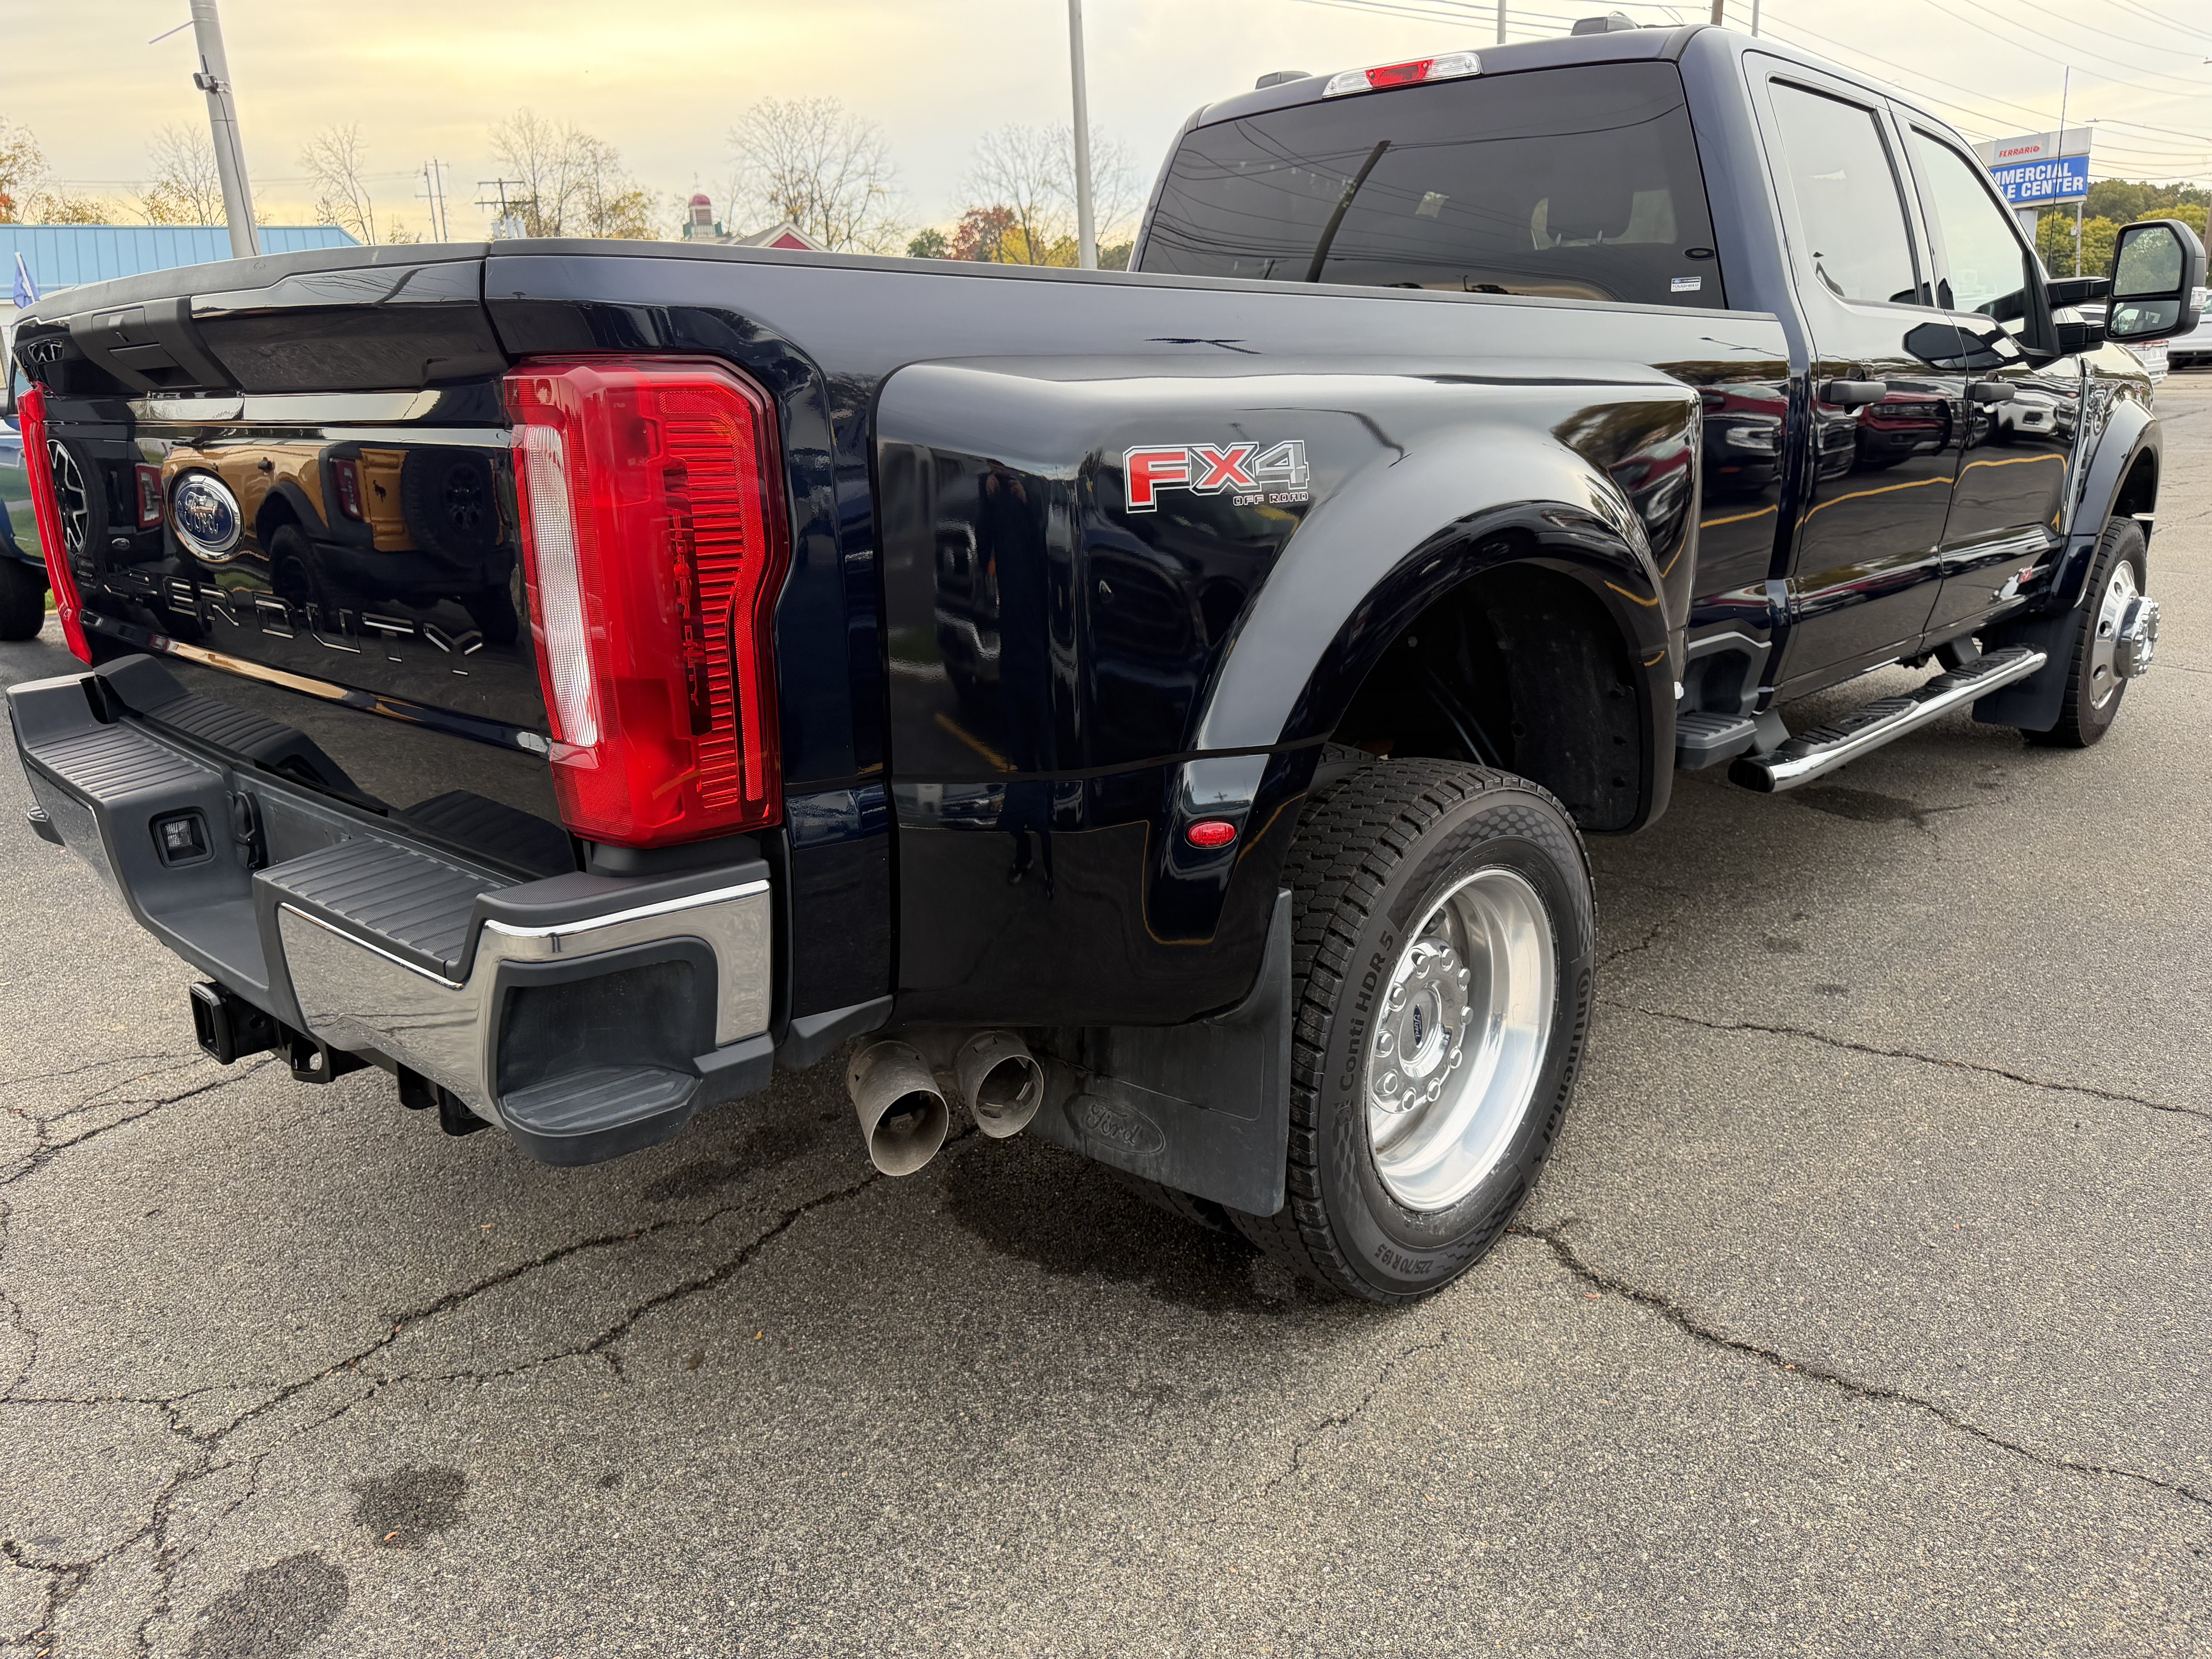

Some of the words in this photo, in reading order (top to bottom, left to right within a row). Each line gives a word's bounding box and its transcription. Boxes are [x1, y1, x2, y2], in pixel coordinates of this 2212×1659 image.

[1999, 146, 2040, 158] FERRARIO
[2021, 176, 2083, 198] CENTER
[1123, 440, 1310, 514] FX4
[177, 491, 218, 534] Ford
[1233, 495, 1264, 506] OFF
[1269, 491, 1309, 503] ROAD
[252, 591, 484, 677] DUTY
[1339, 1017, 1365, 1092] Conti
[1356, 952, 1386, 1013] HDR
[1379, 930, 1394, 952] 5
[1086, 1104, 1141, 1145] Ford
